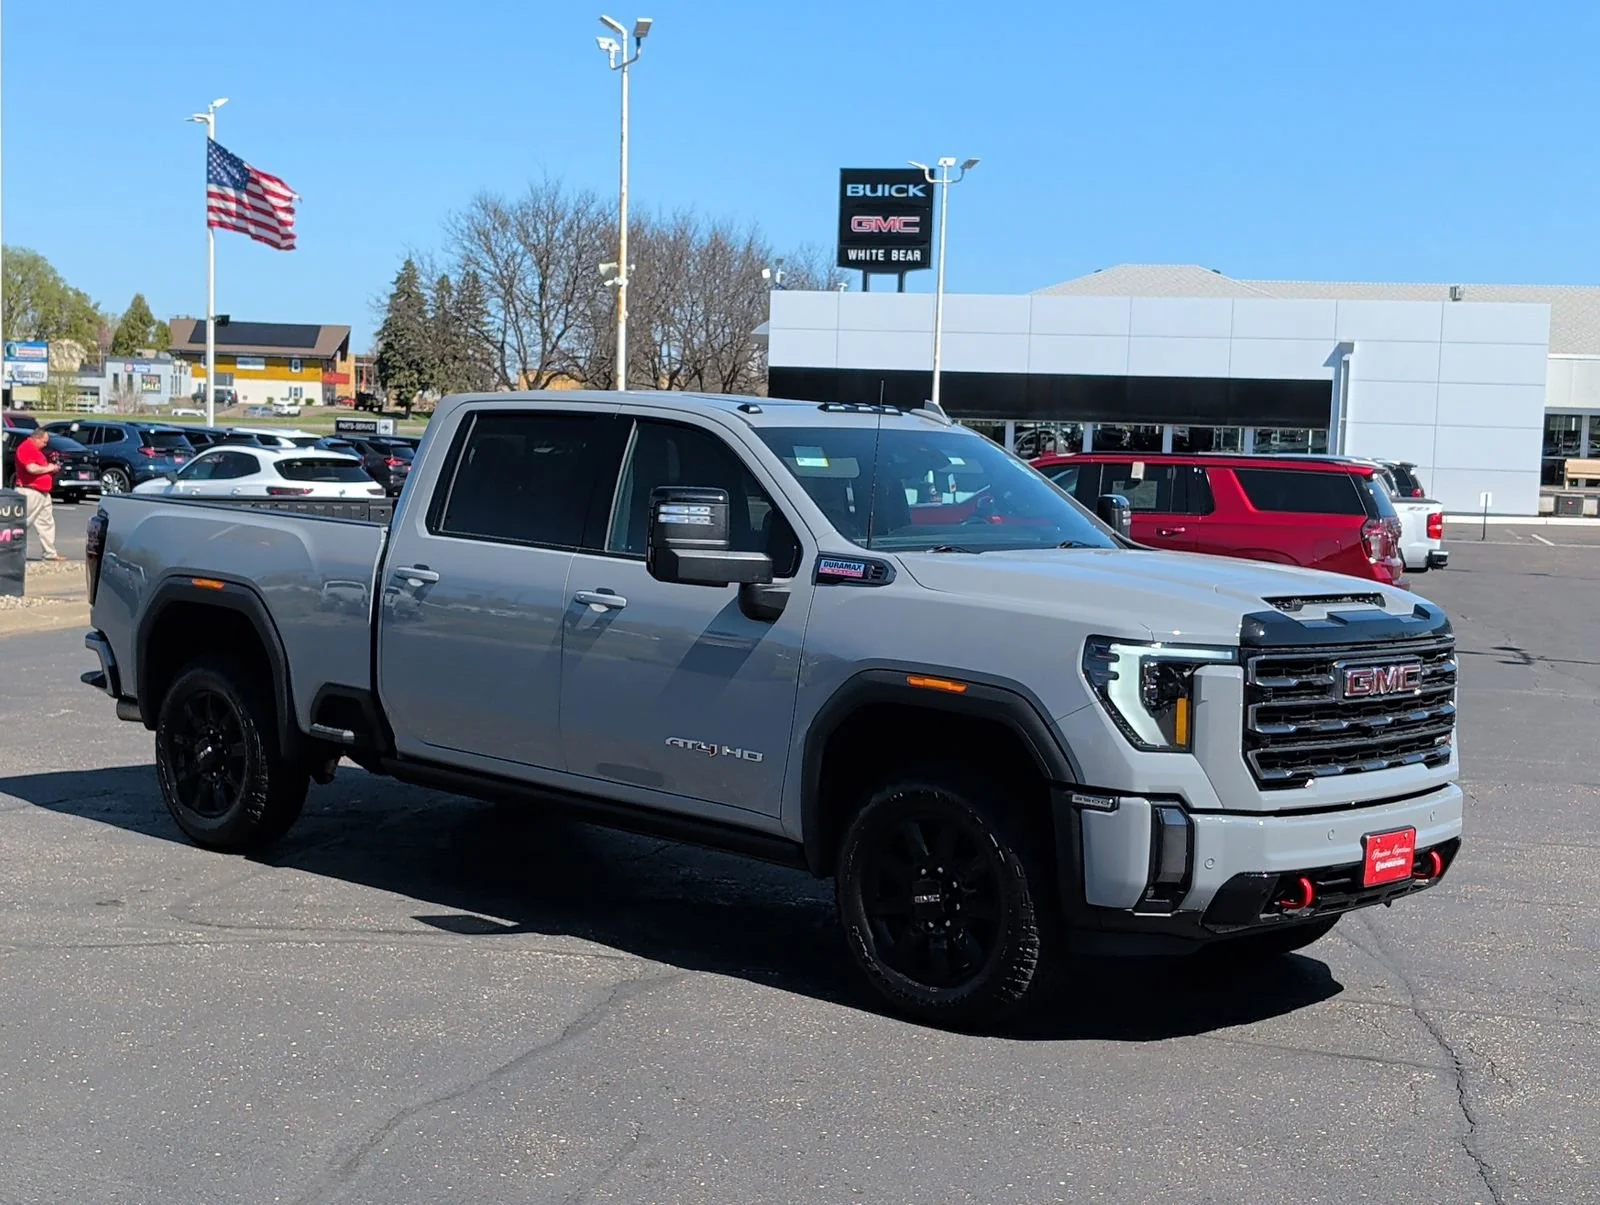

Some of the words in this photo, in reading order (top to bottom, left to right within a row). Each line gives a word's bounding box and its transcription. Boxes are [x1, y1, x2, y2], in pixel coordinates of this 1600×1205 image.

[846, 184, 927, 197] BUICK
[851, 216, 920, 233] GMC
[847, 249, 885, 261] WHITE
[891, 249, 921, 261] BEAR
[823, 561, 862, 571] DURAMAX
[1343, 664, 1421, 697] GMC
